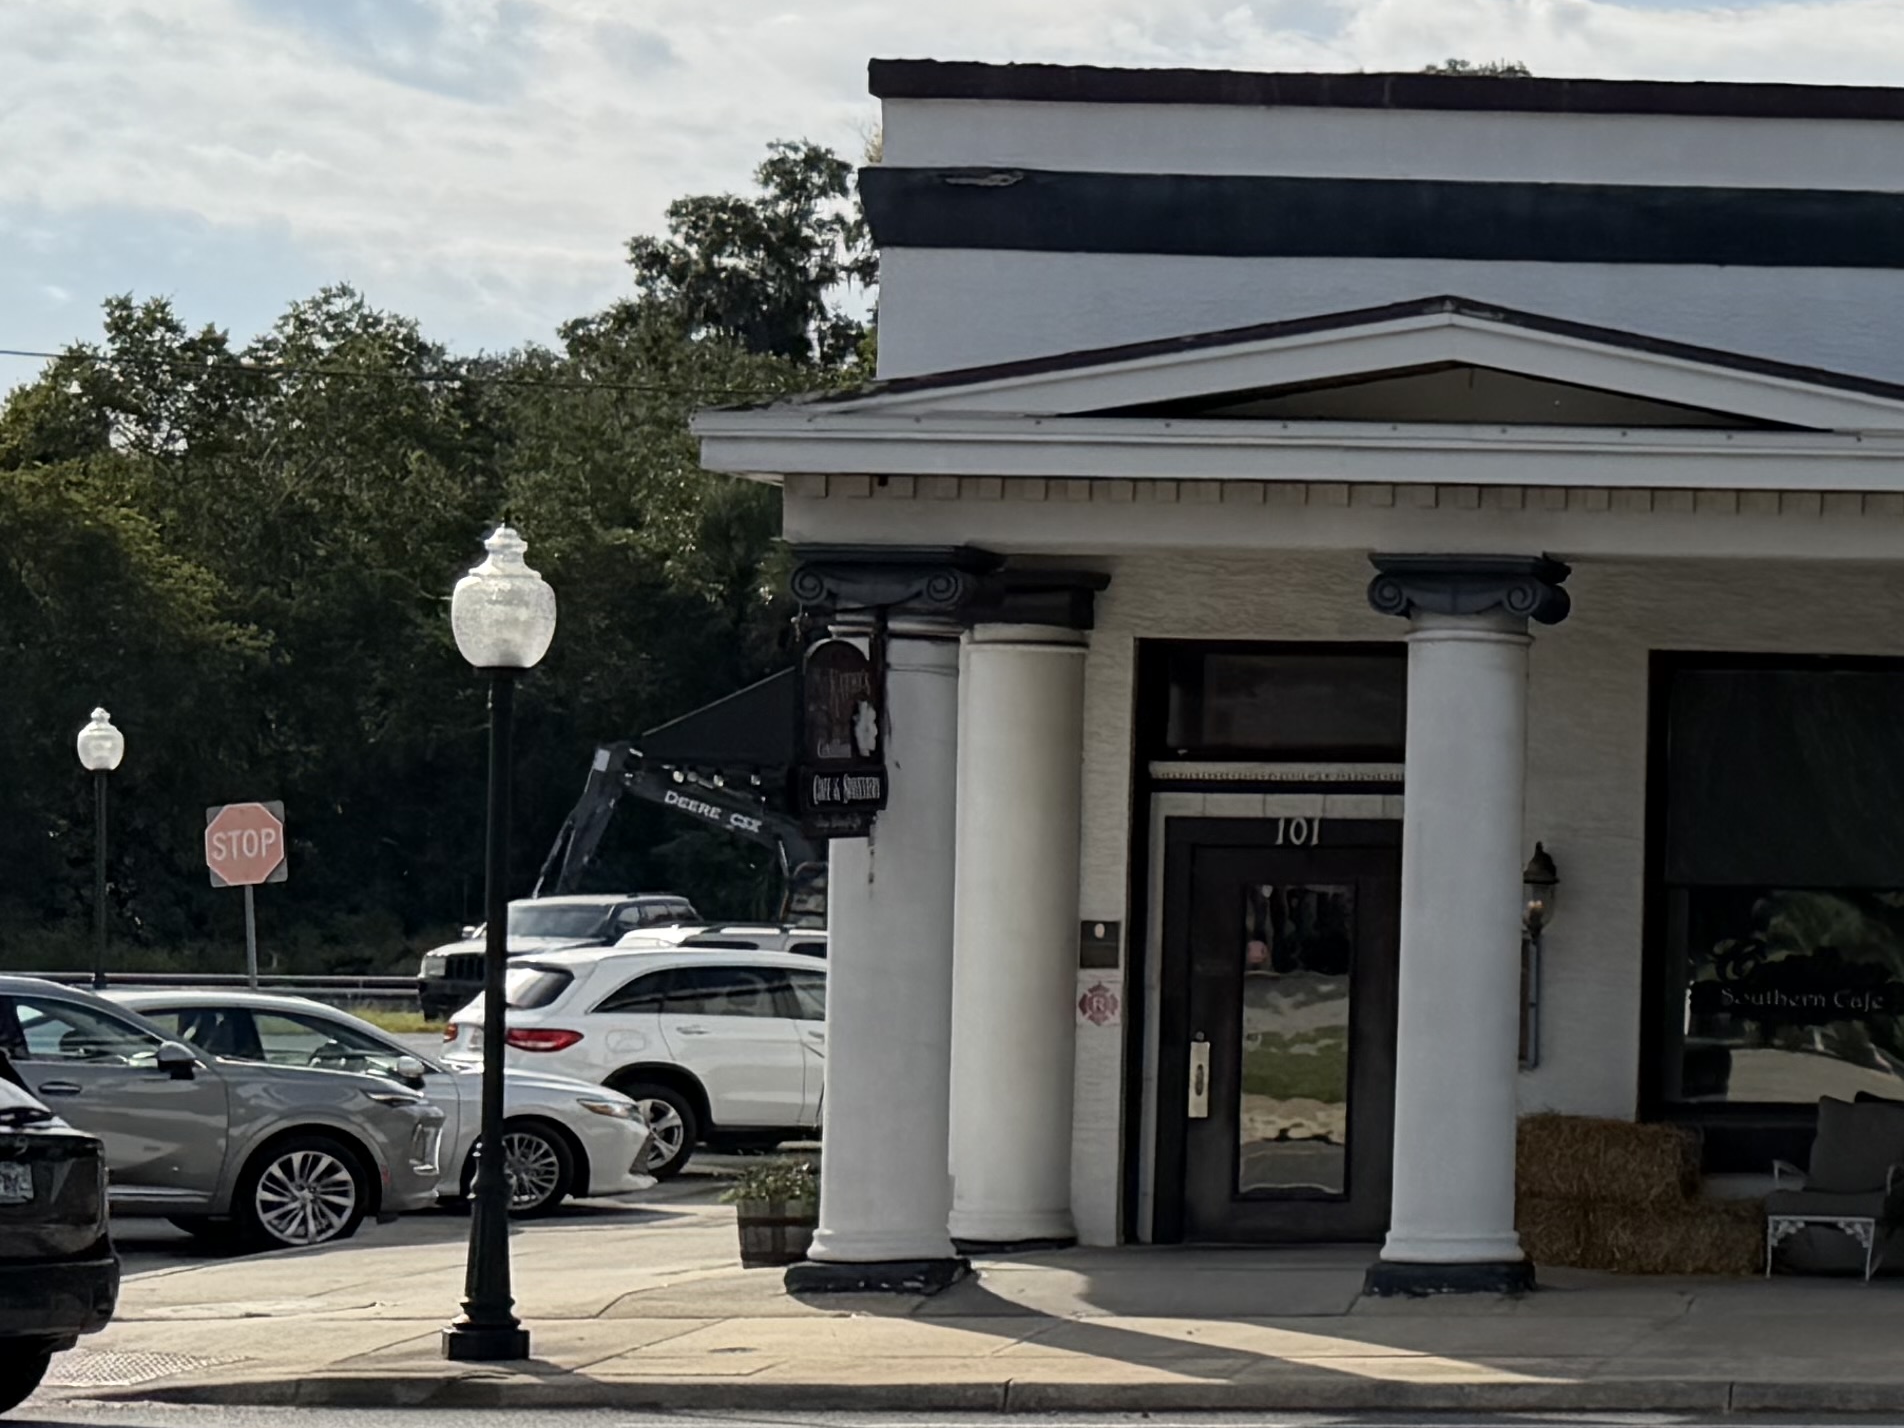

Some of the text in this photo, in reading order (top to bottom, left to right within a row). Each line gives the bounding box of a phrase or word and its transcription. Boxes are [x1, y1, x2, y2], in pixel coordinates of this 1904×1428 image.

[664, 790, 722, 819] DEERE
[211, 827, 276, 861] STOP
[1274, 817, 1321, 847] 101
[1092, 996, 1106, 1012] R
[1721, 987, 1888, 1012] Southern Cafe
